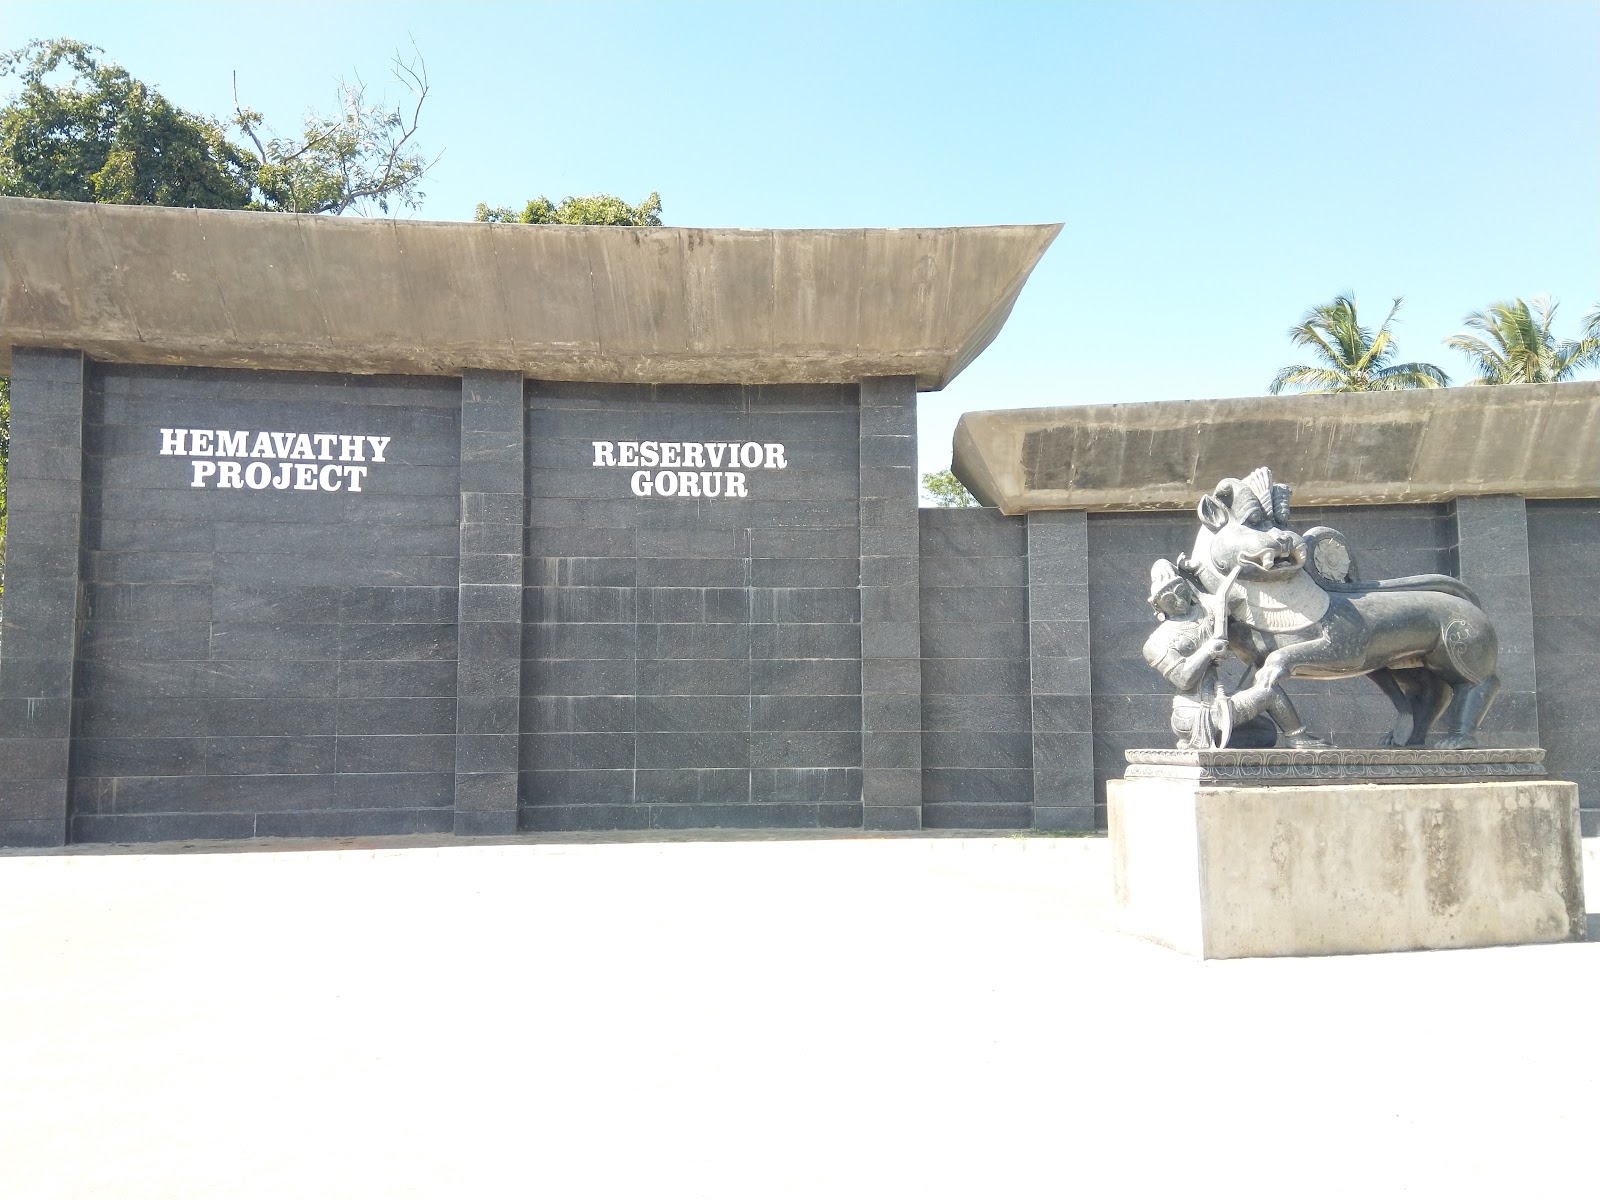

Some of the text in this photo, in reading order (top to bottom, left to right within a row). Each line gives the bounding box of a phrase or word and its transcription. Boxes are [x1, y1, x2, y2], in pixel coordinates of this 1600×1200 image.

[160, 428, 391, 462] HEMAVATHY
[592, 441, 788, 469] RESERVIOR
[190, 461, 367, 492] PROJECT
[630, 470, 749, 498] GORUR
